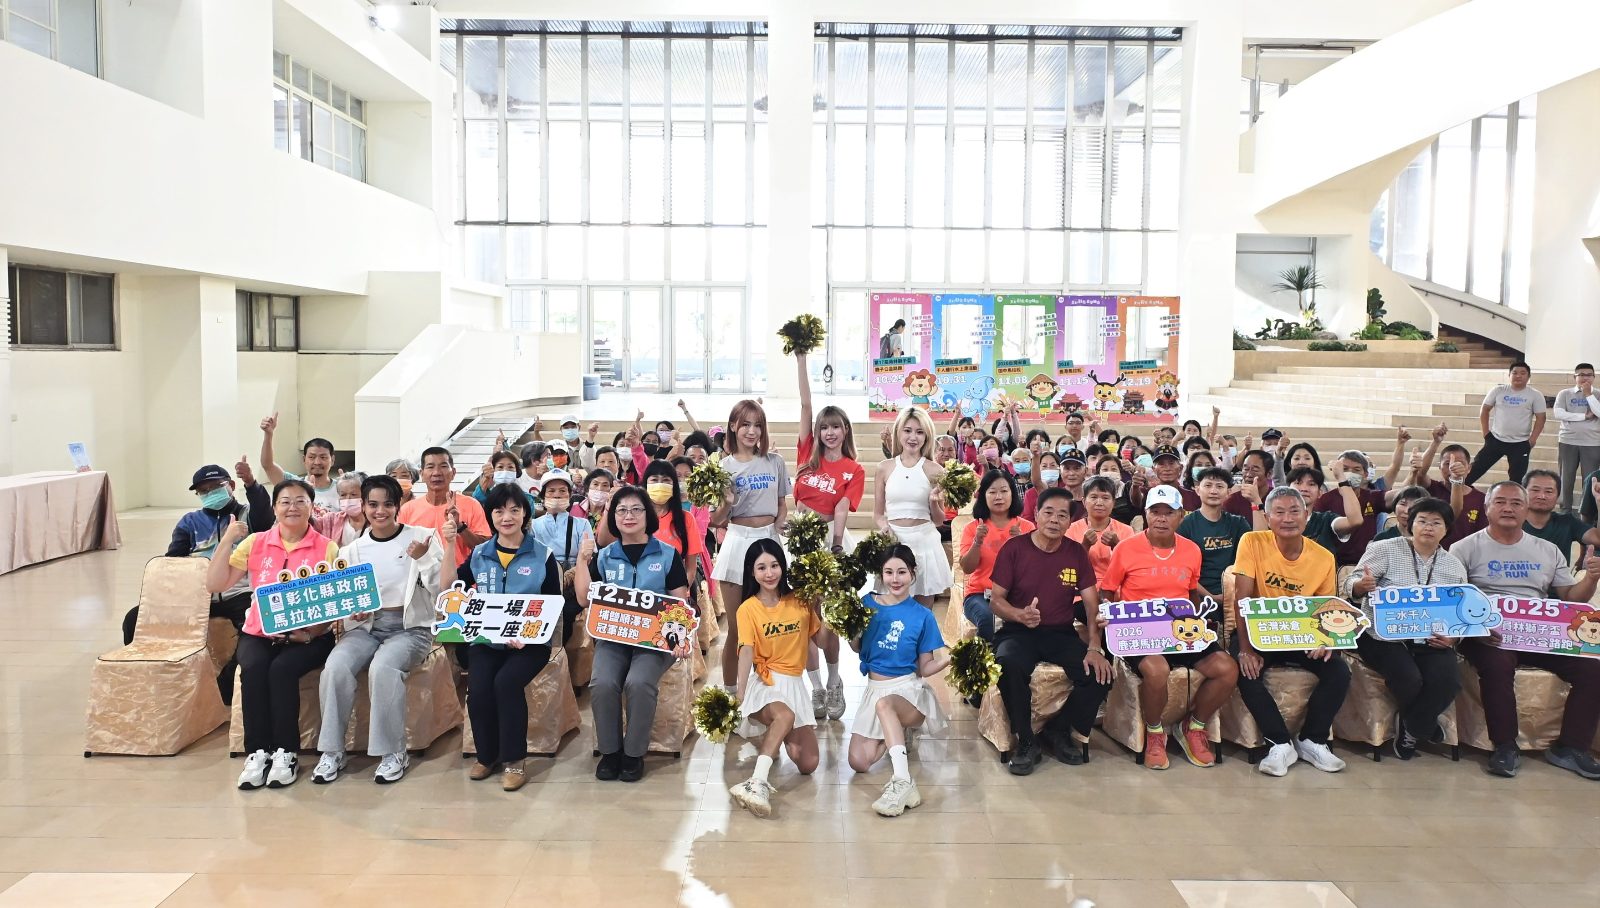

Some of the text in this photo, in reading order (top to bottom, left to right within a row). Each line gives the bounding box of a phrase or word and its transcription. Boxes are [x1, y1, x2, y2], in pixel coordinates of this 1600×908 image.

[875, 374, 904, 384] 10.25
[936, 375, 967, 385] 10.31
[998, 376, 1027, 386] 11.08
[1059, 376, 1089, 386] 11.15
[1121, 377, 1151, 387] 12.19
[748, 475, 776, 484] FAMILY
[750, 482, 769, 491] RUN
[1503, 563, 1541, 571] FAMILY
[259, 566, 369, 595] CHANGHUA MARATHON CARNIVAL
[286, 575, 368, 607] 彰化縣政府
[591, 583, 655, 609] 12.19
[1371, 586, 1441, 605] 10.31
[274, 594, 372, 629] 馬拉松嘉年華
[464, 599, 544, 617] 跑一場馬
[1101, 600, 1167, 620] 11.15
[1241, 598, 1309, 615] 11.08
[1490, 597, 1560, 617] 10.25
[599, 609, 651, 629] 埔鹽順澤宮
[1385, 608, 1431, 622] 二水千人
[462, 620, 549, 639] 玩一座城!
[596, 622, 639, 640] 冠軍路跑
[1116, 626, 1143, 637] 2026
[1258, 621, 1300, 632] 台灣米倉
[1502, 622, 1561, 636] 員林獅子盃
[1118, 637, 1172, 651] 鹿港馬拉松
[1260, 634, 1316, 645] 田中馬拉松
[1502, 633, 1574, 650] 親子公益路跑
